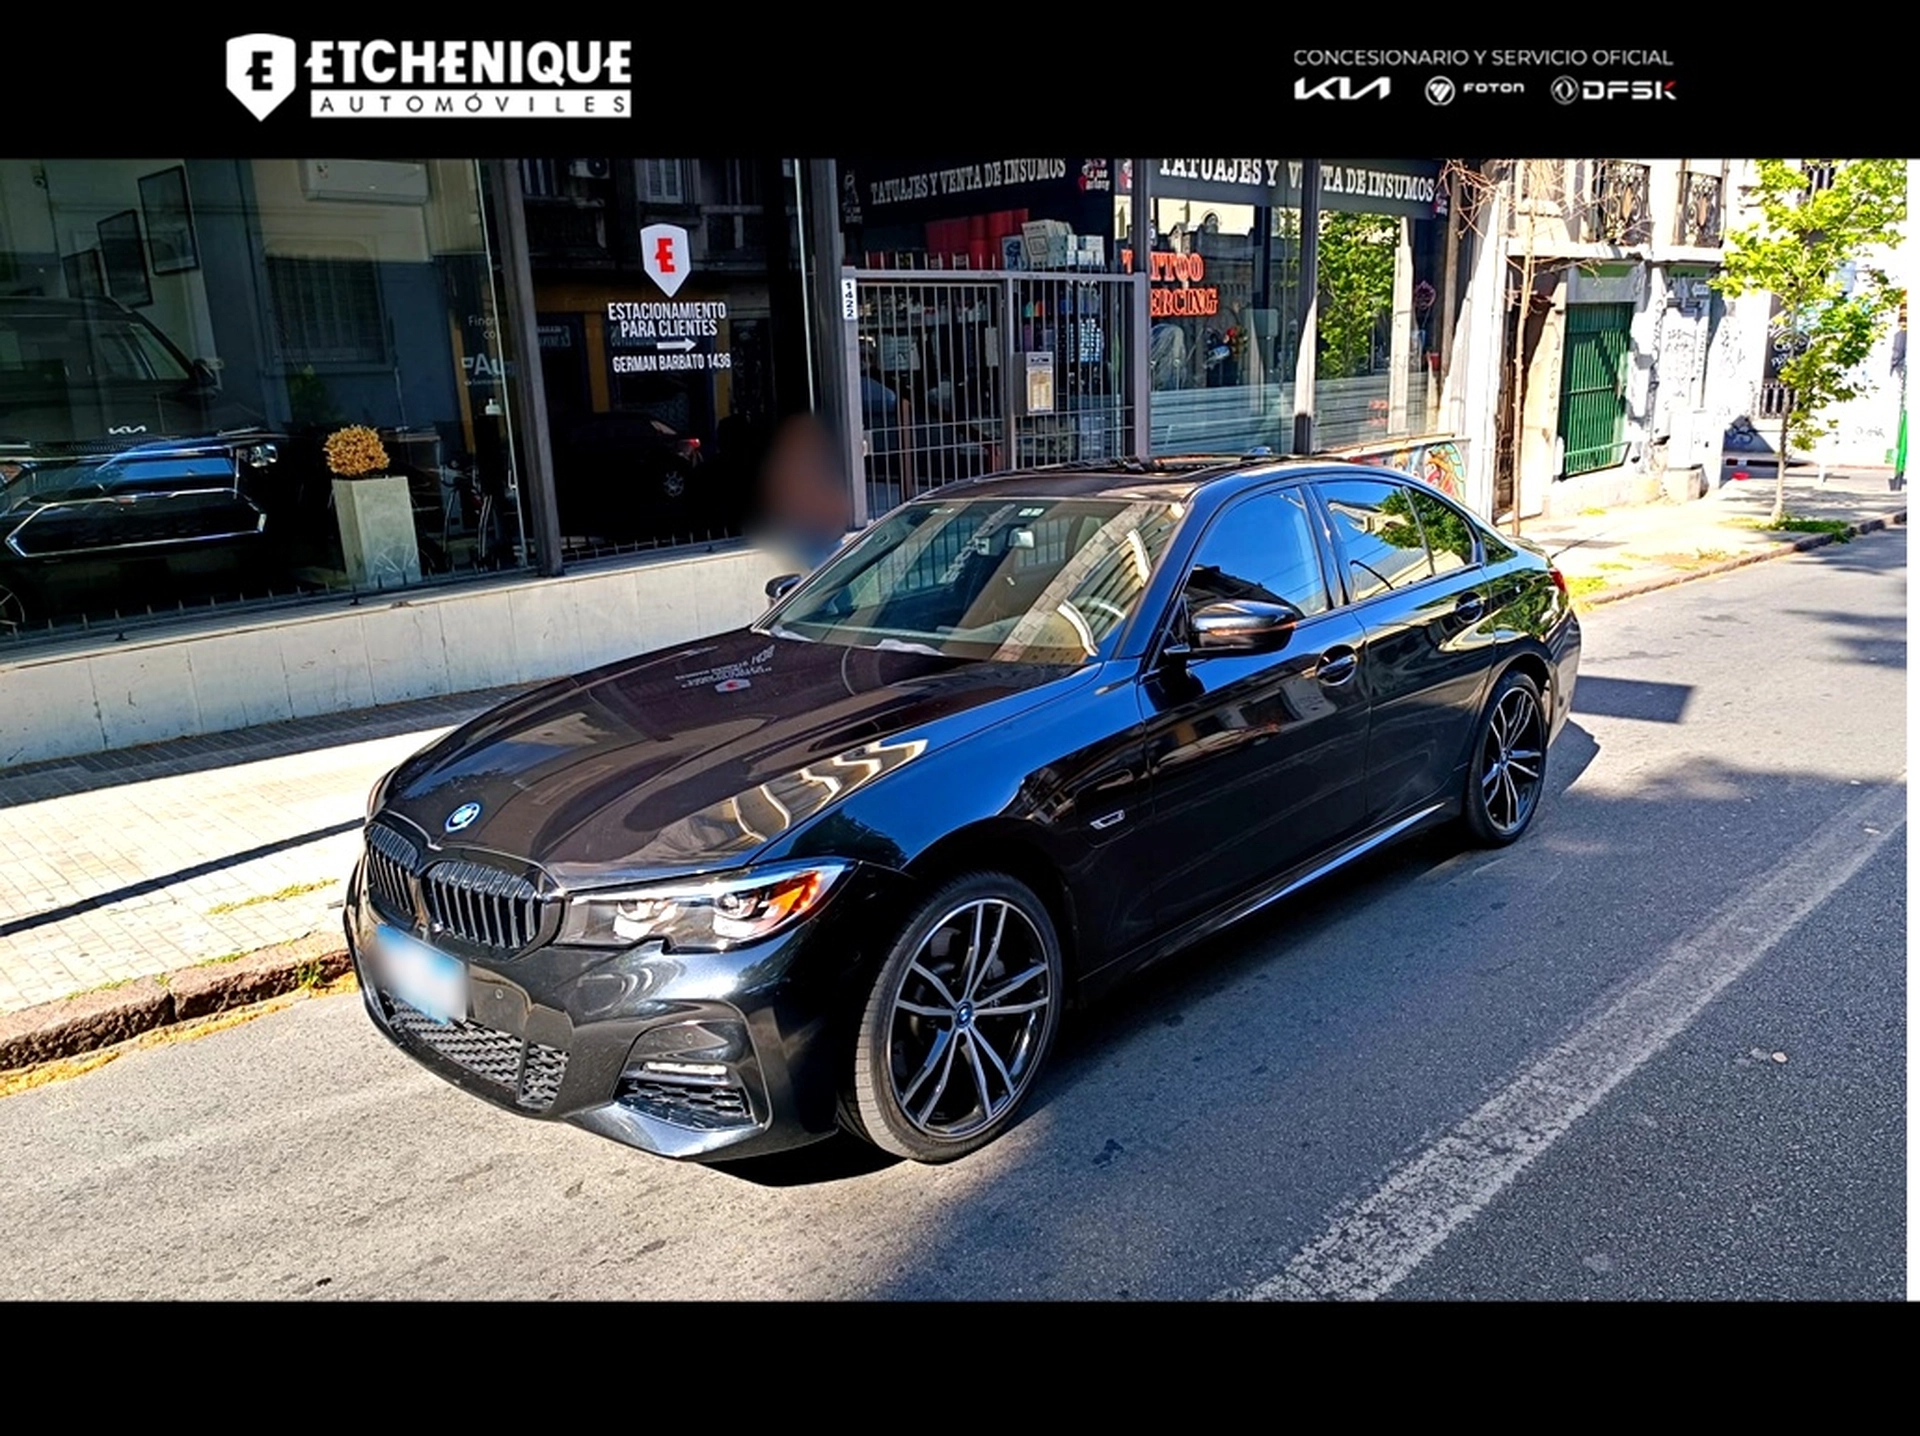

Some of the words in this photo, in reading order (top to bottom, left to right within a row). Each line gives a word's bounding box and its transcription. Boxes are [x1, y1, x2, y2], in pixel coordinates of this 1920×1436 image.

[871, 172, 929, 205] TATUAJES
[928, 171, 939, 196] Y
[939, 165, 983, 195] VENTA
[983, 161, 1001, 188] DE
[1003, 157, 1067, 186] INSUMOS
[1159, 158, 1263, 186] TATUAJES
[1264, 158, 1280, 187] Y
[1345, 167, 1367, 196] DE
[1367, 170, 1435, 203] INSUMOS
[607, 302, 727, 321] ESTACIONAMIENTO
[620, 320, 656, 338] PARA
[658, 319, 718, 337] CLIENTES
[612, 354, 658, 373] GERMAN
[659, 352, 705, 371] BARBATO
[707, 351, 731, 369] 1436
